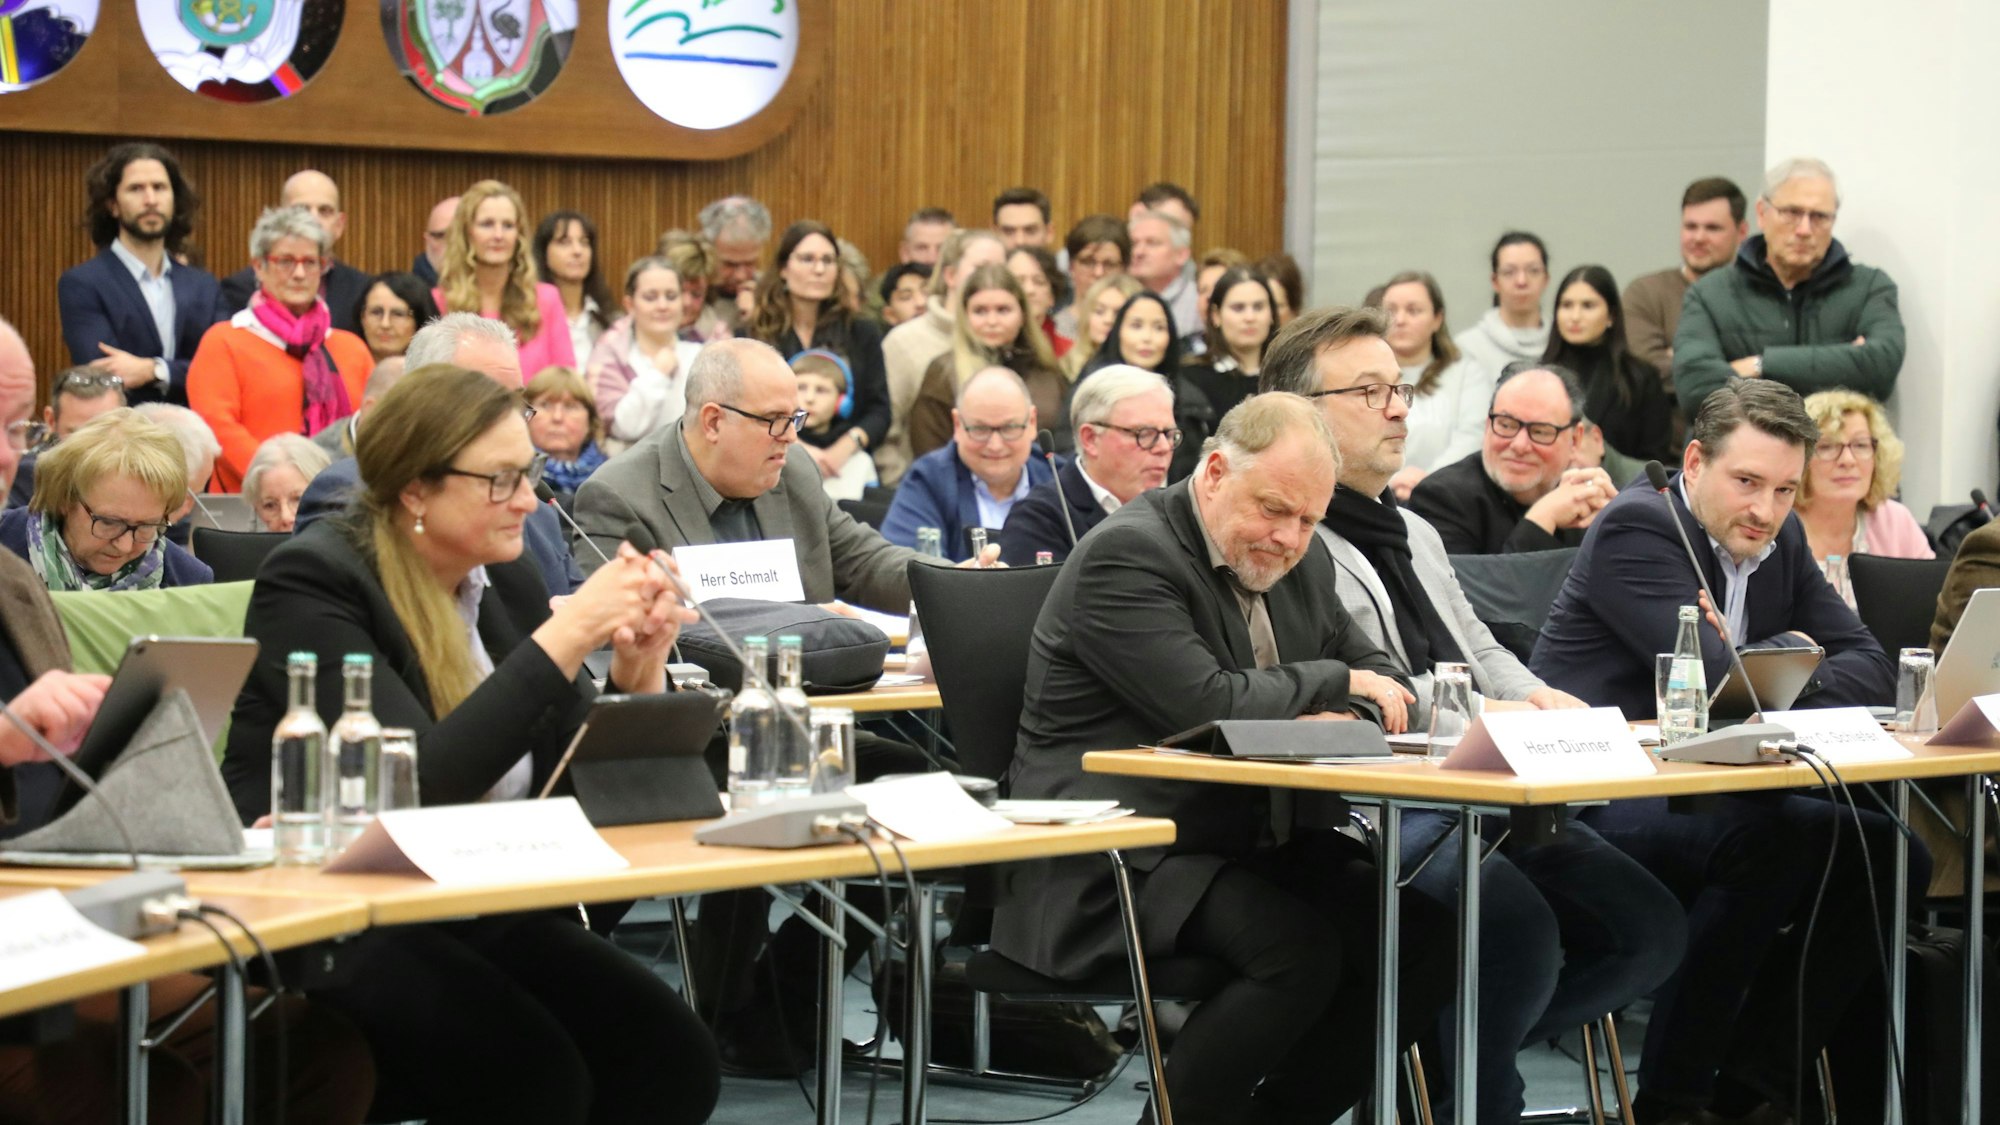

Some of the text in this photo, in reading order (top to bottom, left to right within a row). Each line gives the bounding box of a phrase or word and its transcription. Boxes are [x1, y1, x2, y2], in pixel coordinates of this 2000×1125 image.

[700, 569, 779, 587] Herr Schmalt
[1523, 739, 1612, 755] Herr Dünner
[1795, 735, 1817, 745] err
